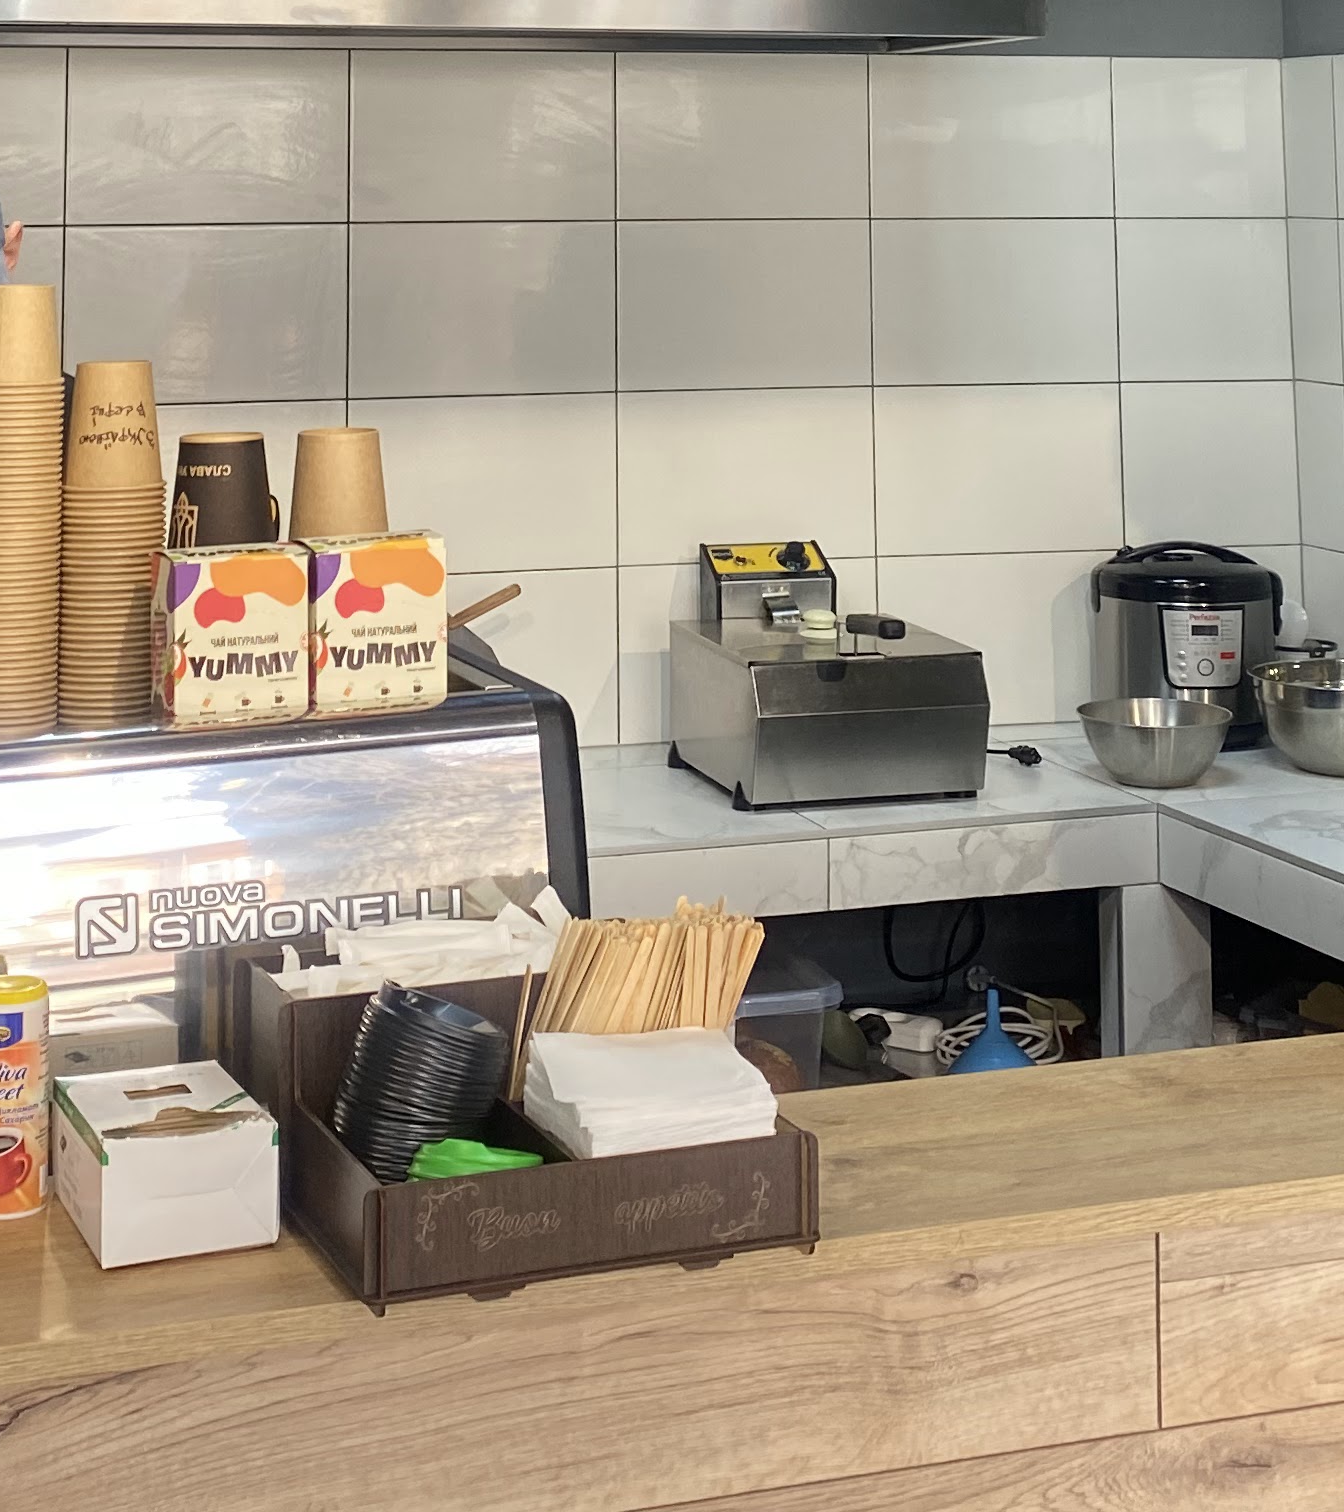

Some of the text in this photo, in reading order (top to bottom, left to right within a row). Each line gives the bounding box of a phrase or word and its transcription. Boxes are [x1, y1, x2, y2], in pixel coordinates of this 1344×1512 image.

[189, 464, 232, 477] СЛАВА
[211, 633, 279, 648] ЧАЙ НАТУРАЛЬНИЙ
[351, 624, 418, 638] ЧАЙ НАТУРАЛЬНИЙ
[188, 650, 298, 681] YUMMY
[330, 641, 437, 671] YUMMY
[151, 880, 265, 913] nuova
[151, 886, 462, 951] SIMONELLI
